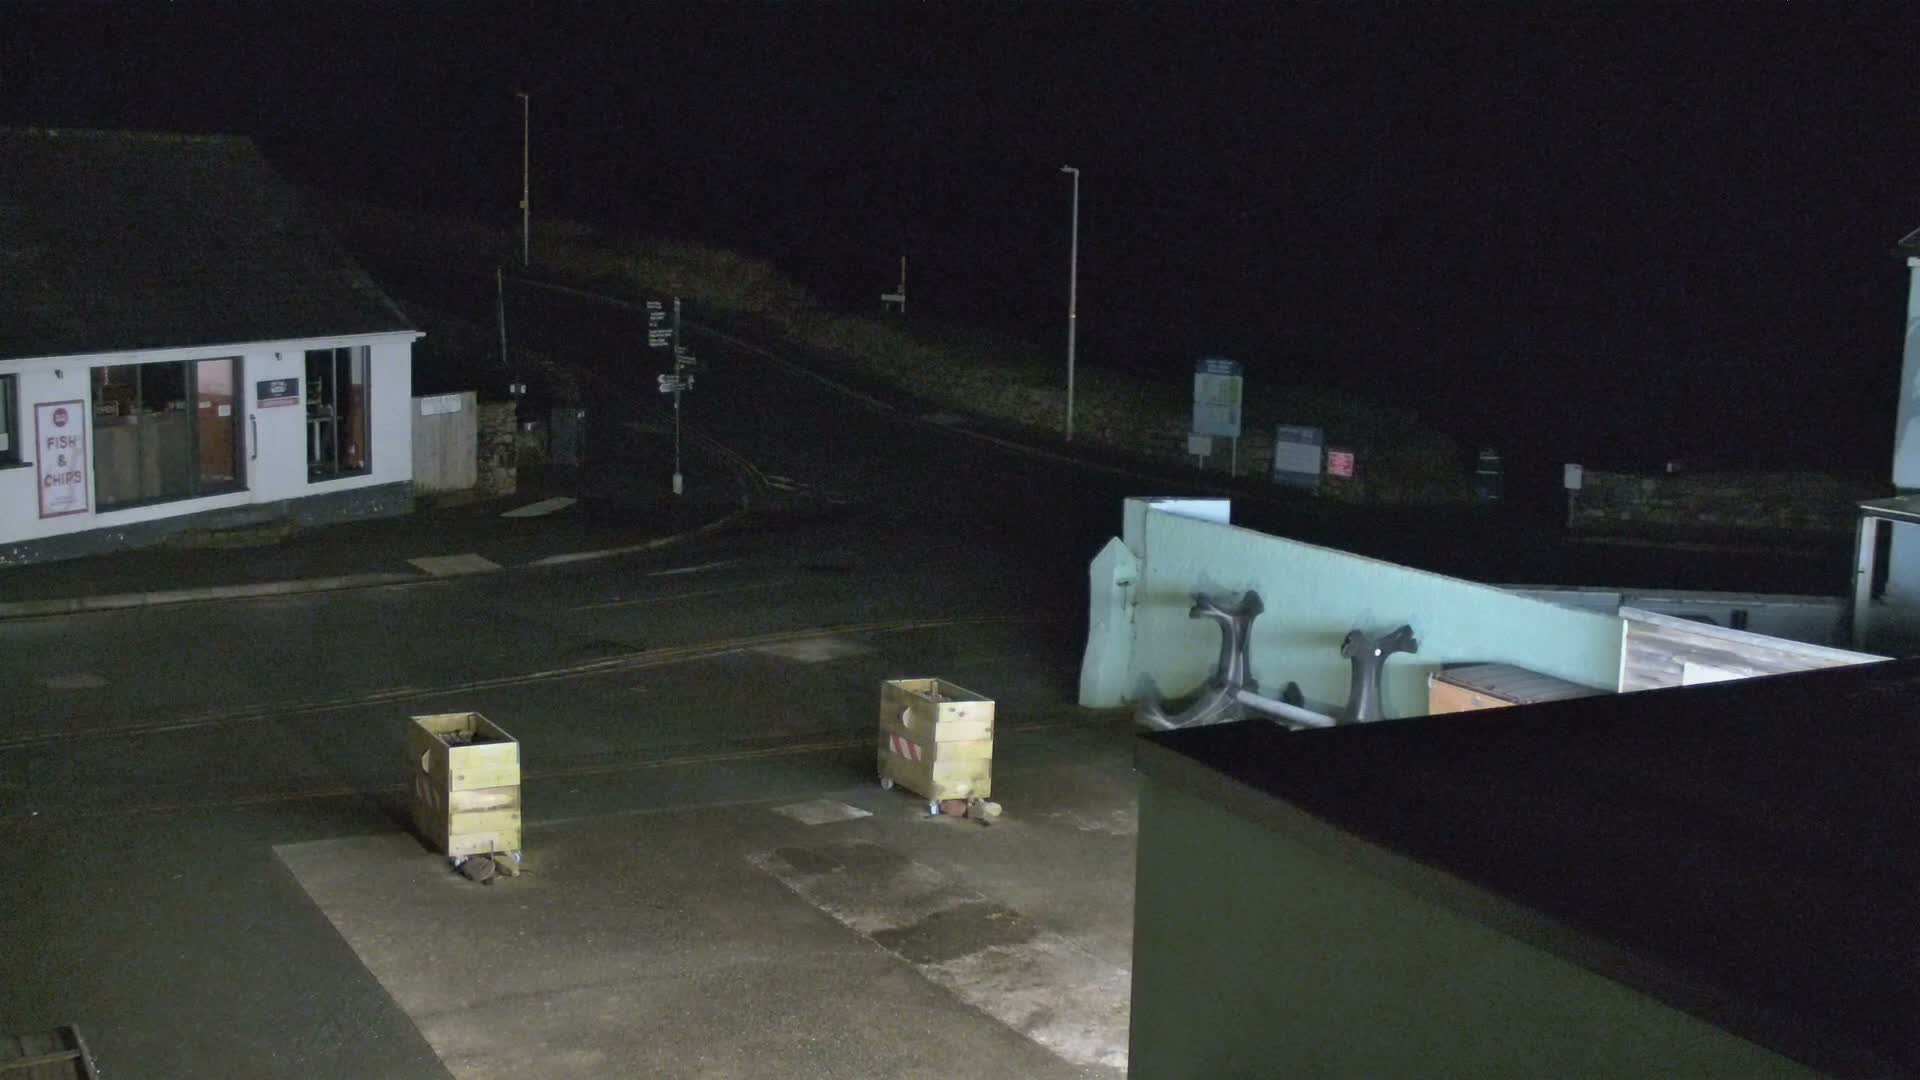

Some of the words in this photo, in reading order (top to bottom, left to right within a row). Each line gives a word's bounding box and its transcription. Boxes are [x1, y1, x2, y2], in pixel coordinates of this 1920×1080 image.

[47, 435, 77, 450] FISH
[57, 454, 67, 467] &
[44, 471, 82, 487] CHIPS
